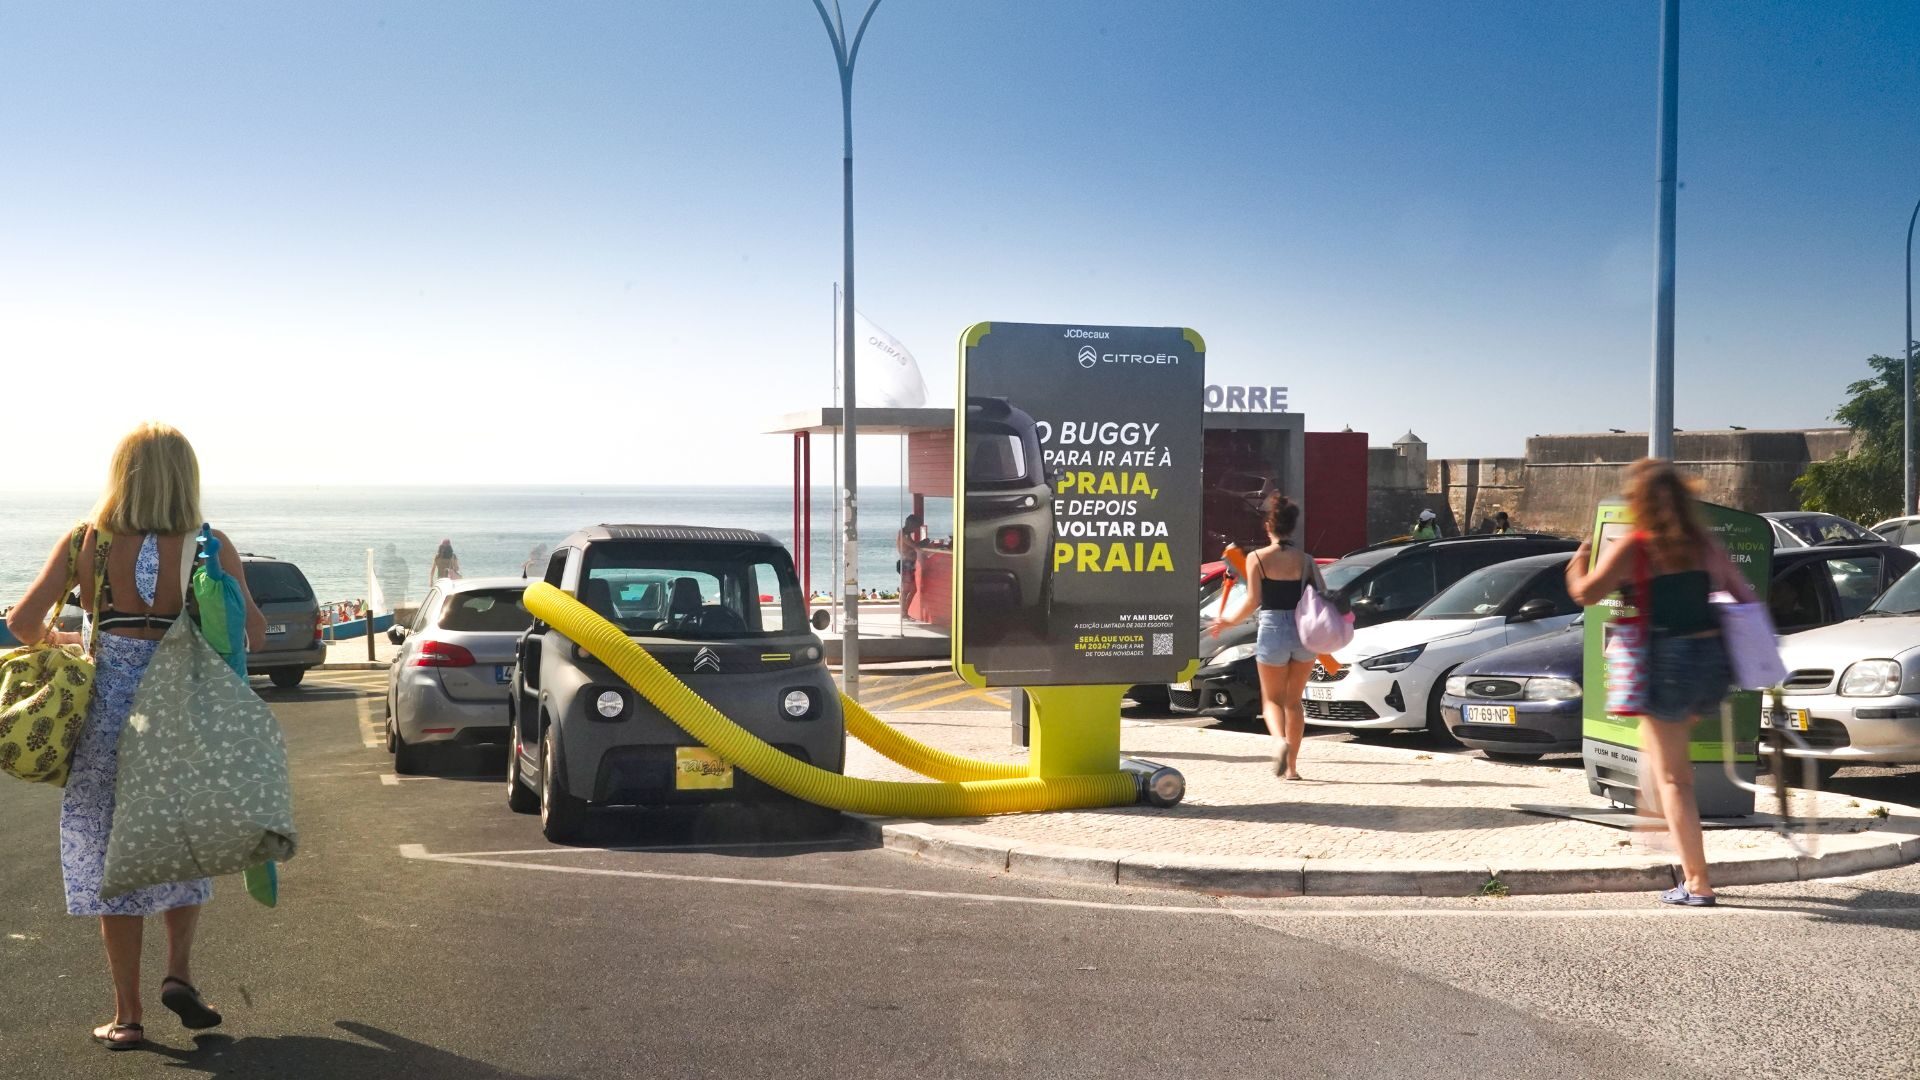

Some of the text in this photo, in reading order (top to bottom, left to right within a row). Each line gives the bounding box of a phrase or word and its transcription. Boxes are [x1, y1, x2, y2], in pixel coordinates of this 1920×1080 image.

[1063, 329, 1110, 339] JCDecaux
[869, 336, 906, 366] OEIRAS
[1204, 384, 1288, 409] ORRE
[1036, 421, 1159, 445] O BUGGY
[1043, 446, 1172, 467] PARA IR ATÉ À
[1057, 471, 1158, 499] PRAIA,
[1054, 500, 1137, 516] E DEPOIS
[1056, 521, 1169, 537] VOLTAR DA
[1738, 542, 1764, 551] NOVA
[1054, 542, 1175, 572] PRAIA
[1079, 634, 1100, 643] SERÁ
[1595, 748, 1609, 756] PUSH
[1621, 754, 1637, 763] DOWN
